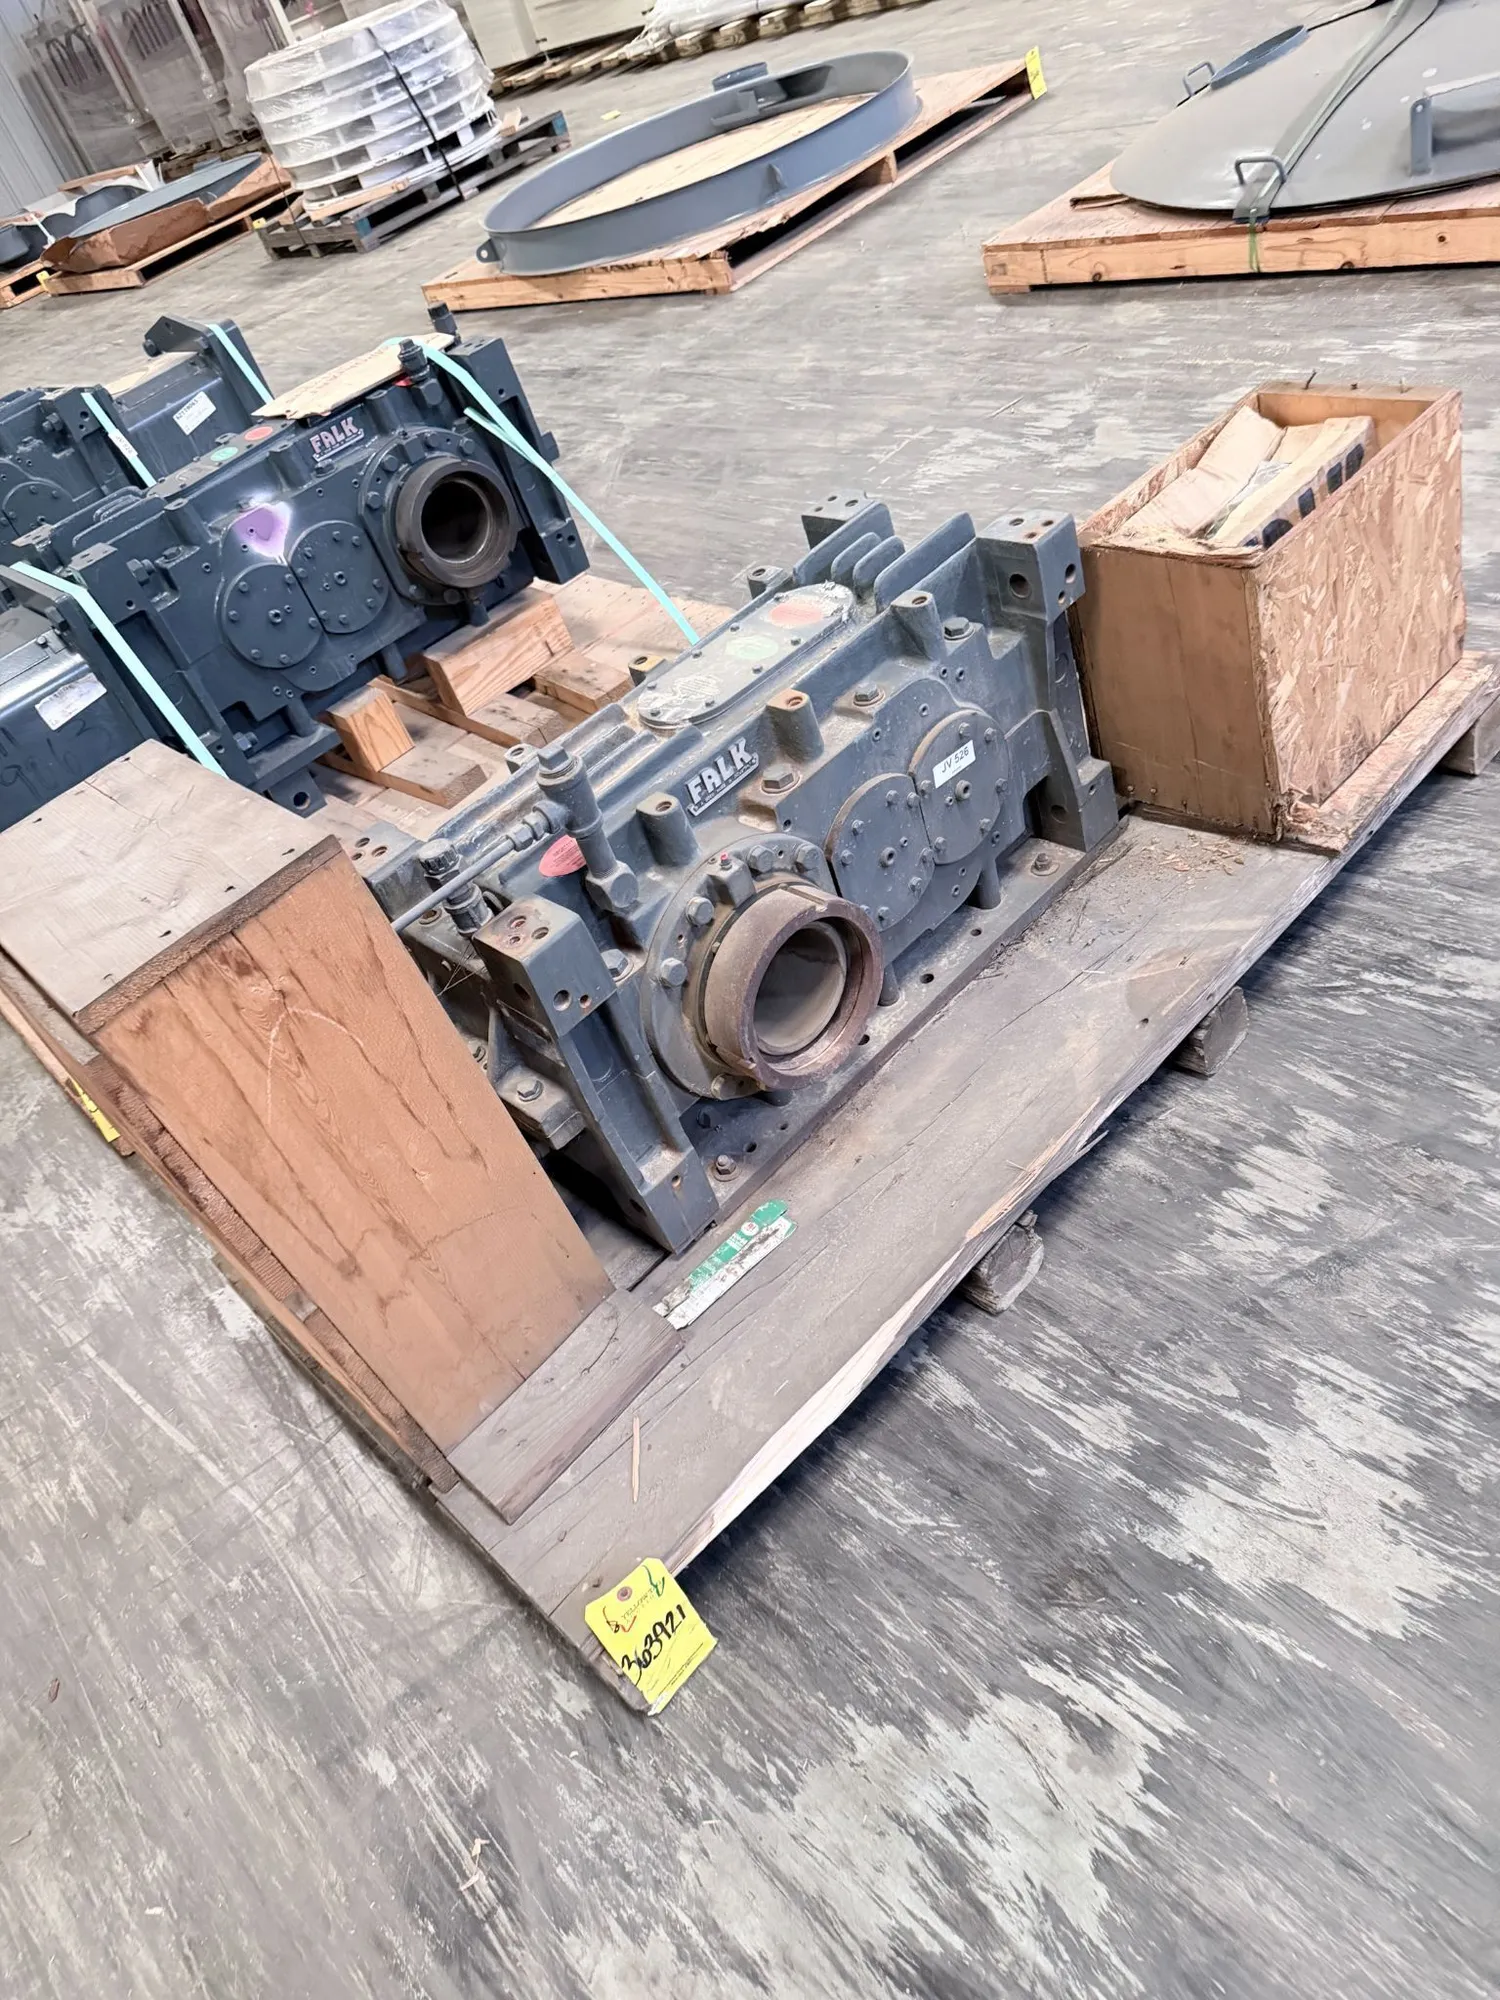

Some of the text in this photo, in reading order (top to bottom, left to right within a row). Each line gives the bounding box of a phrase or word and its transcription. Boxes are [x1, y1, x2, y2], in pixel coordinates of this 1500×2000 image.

[309, 416, 359, 454] FALK
[685, 736, 753, 805] FALK
[941, 757, 952, 773] JV
[953, 746, 970, 764] 526
[621, 1603, 687, 1687] 363921
